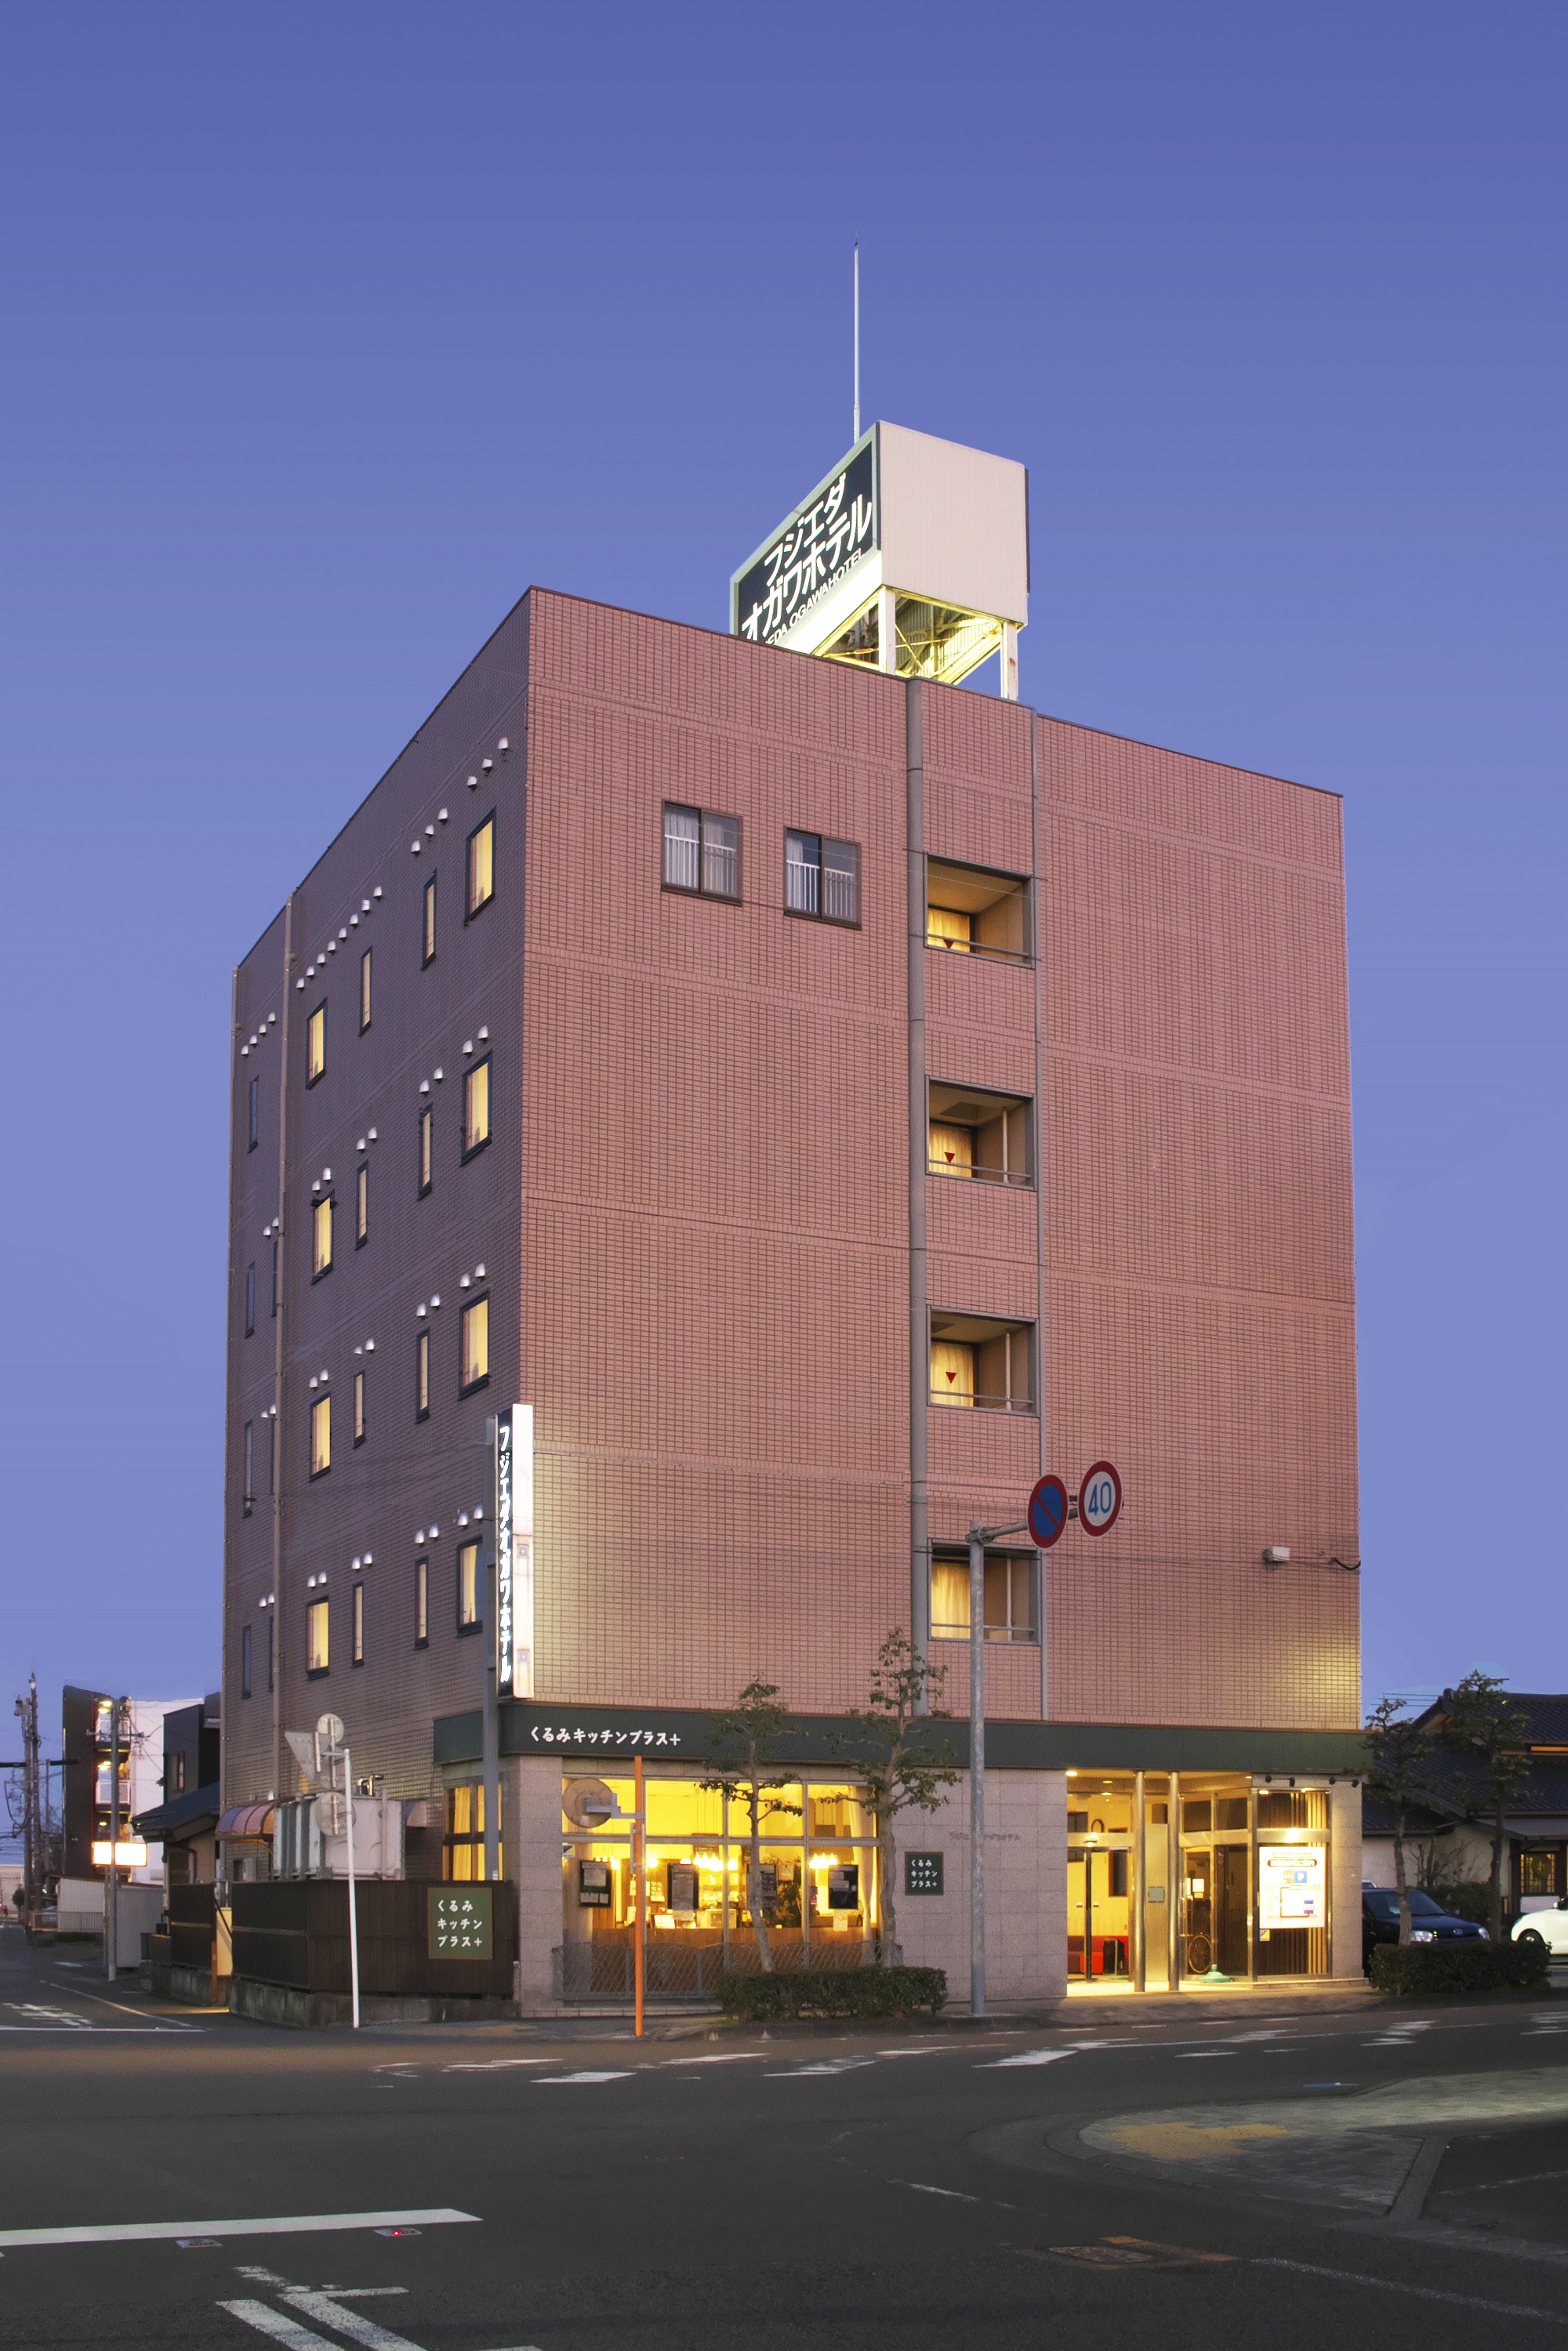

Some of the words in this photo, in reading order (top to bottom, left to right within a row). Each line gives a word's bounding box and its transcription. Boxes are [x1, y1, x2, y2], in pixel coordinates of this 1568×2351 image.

[764, 472, 847, 587] フジエダ
[741, 493, 873, 641] オガワホテル
[1088, 1481, 1112, 1516] 40
[911, 1859, 933, 1867] くるみ
[437, 1899, 474, 1913] くるみ
[437, 1917, 483, 1930] キッチン
